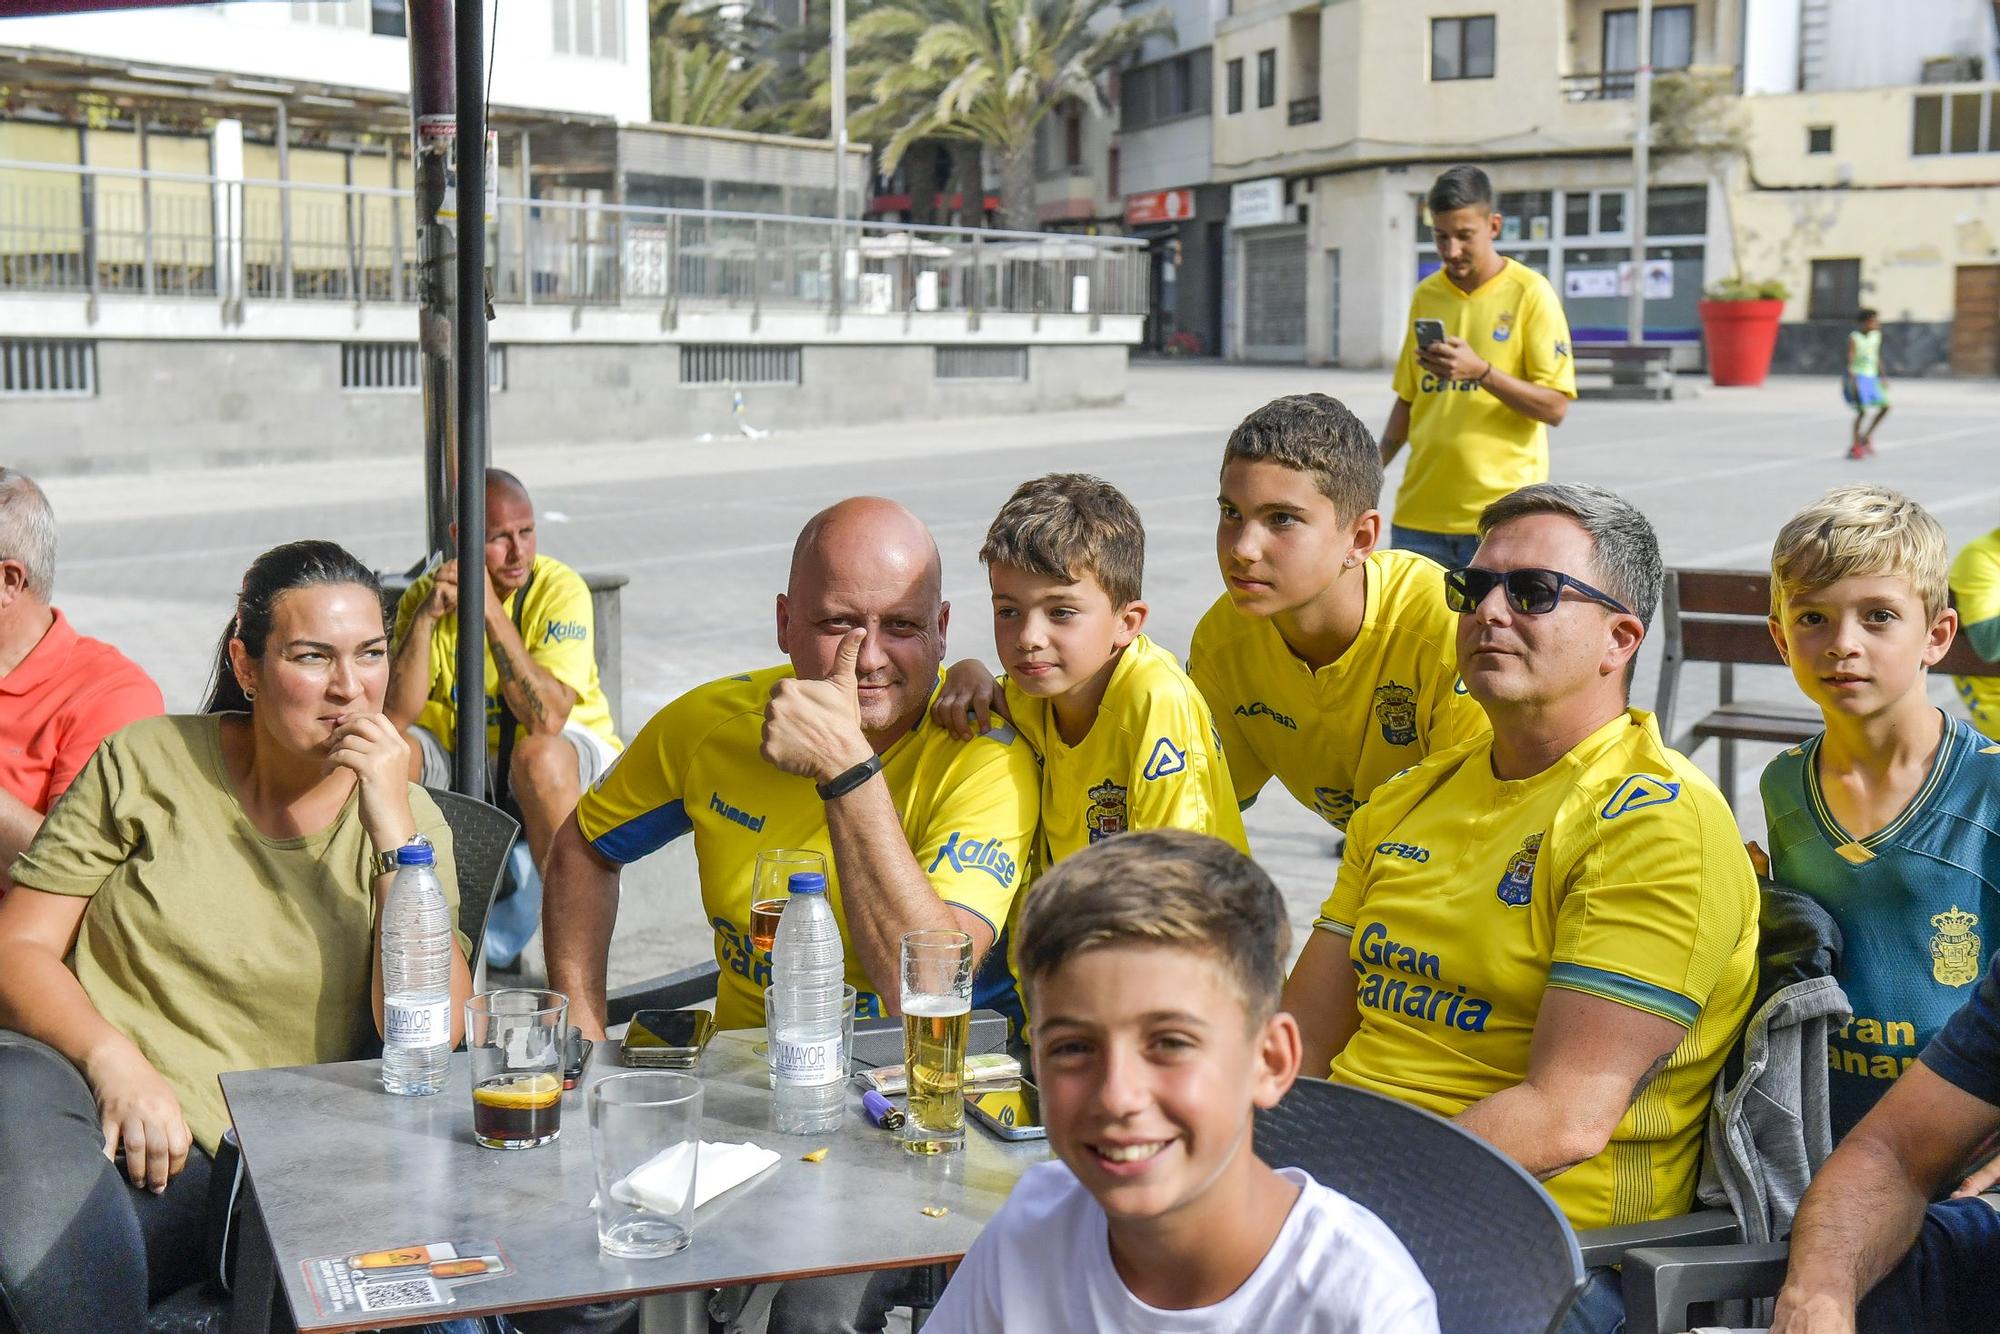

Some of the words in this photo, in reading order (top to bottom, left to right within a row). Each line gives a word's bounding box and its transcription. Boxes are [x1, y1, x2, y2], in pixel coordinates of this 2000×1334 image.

[709, 791, 766, 833] hummel
[928, 831, 1015, 888] Kalise
[1358, 921, 1440, 981] Gran
[1839, 1016, 1916, 1046] ran
